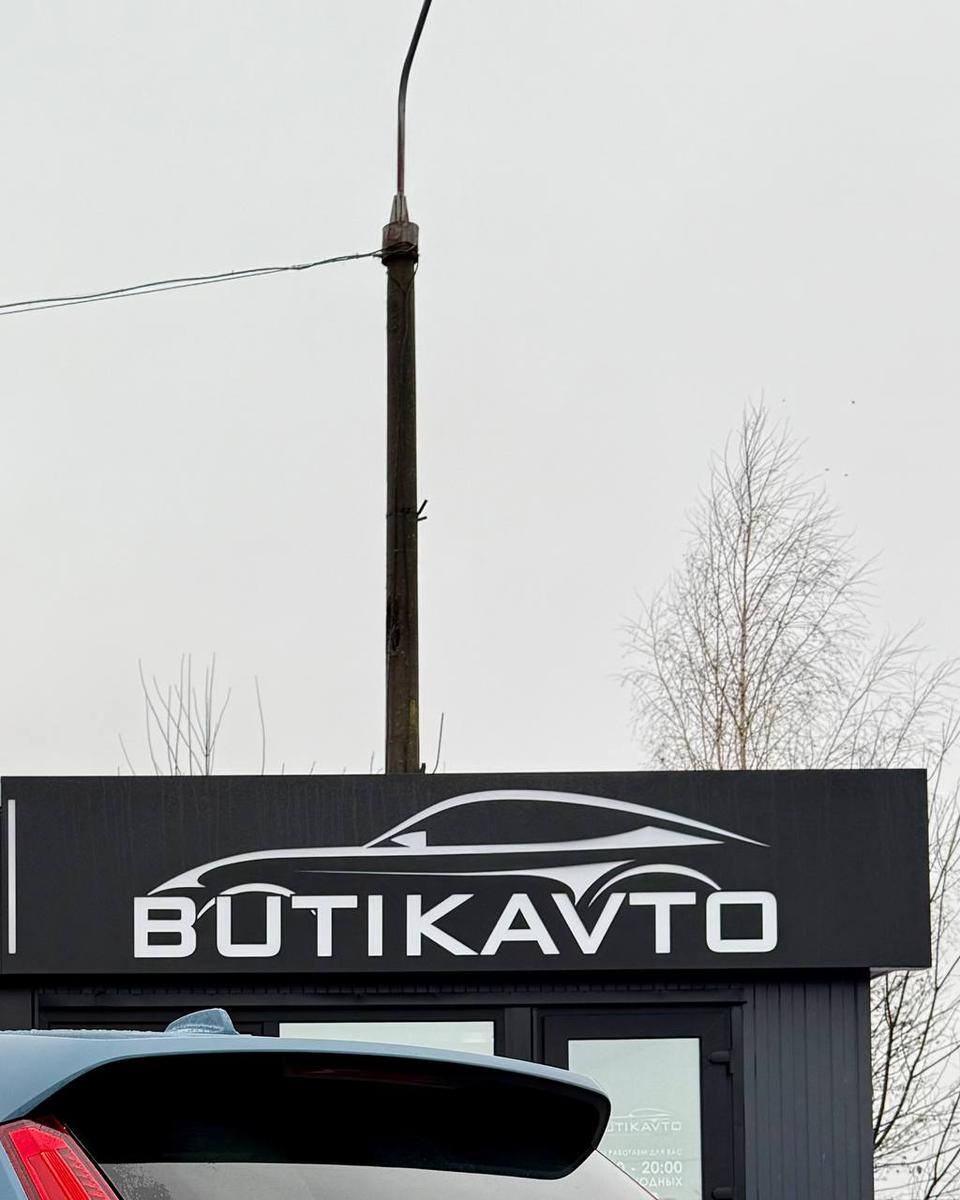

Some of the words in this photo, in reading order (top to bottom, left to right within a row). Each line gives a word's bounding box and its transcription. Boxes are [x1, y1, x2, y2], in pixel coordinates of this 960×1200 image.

[133, 889, 777, 958] BUTIKAVTO
[608, 1121, 682, 1132] UTIKAVTO
[642, 1160, 682, 1174] 20:00
[640, 1176, 683, 1187] ОДНЫХ
